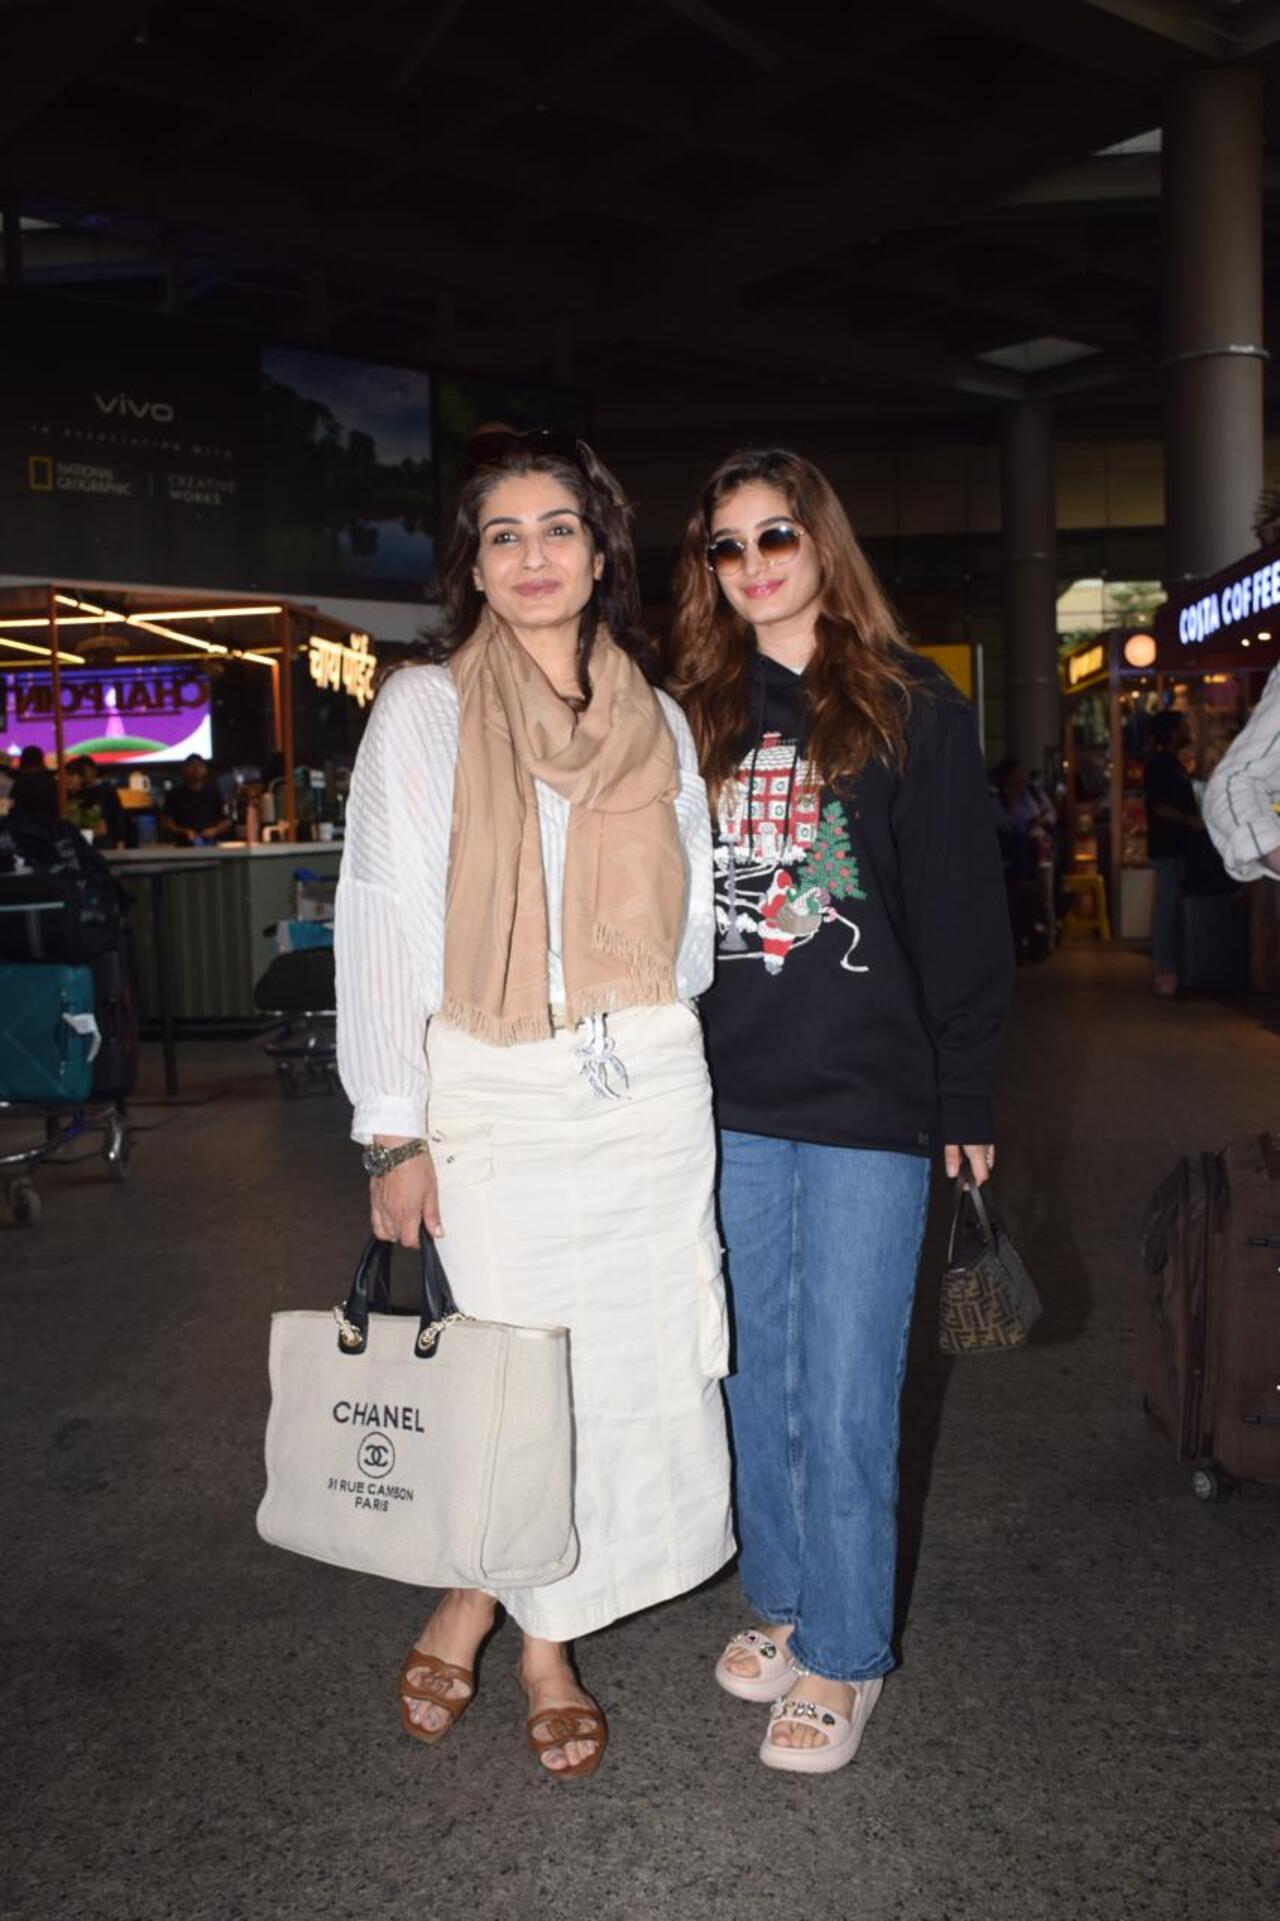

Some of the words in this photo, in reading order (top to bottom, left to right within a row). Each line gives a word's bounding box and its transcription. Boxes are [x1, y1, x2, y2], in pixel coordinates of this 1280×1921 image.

[94, 393, 175, 423] vivo
[168, 474, 238, 495] CREATIVE
[169, 489, 224, 506] WORKS
[1179, 593, 1221, 644] COSTA
[1221, 560, 1280, 625] COFFEE
[332, 1400, 425, 1433] CHANEL
[339, 1479, 366, 1495] RUE
[367, 1483, 414, 1502] CAMBON
[354, 1496, 390, 1513] PARIS
